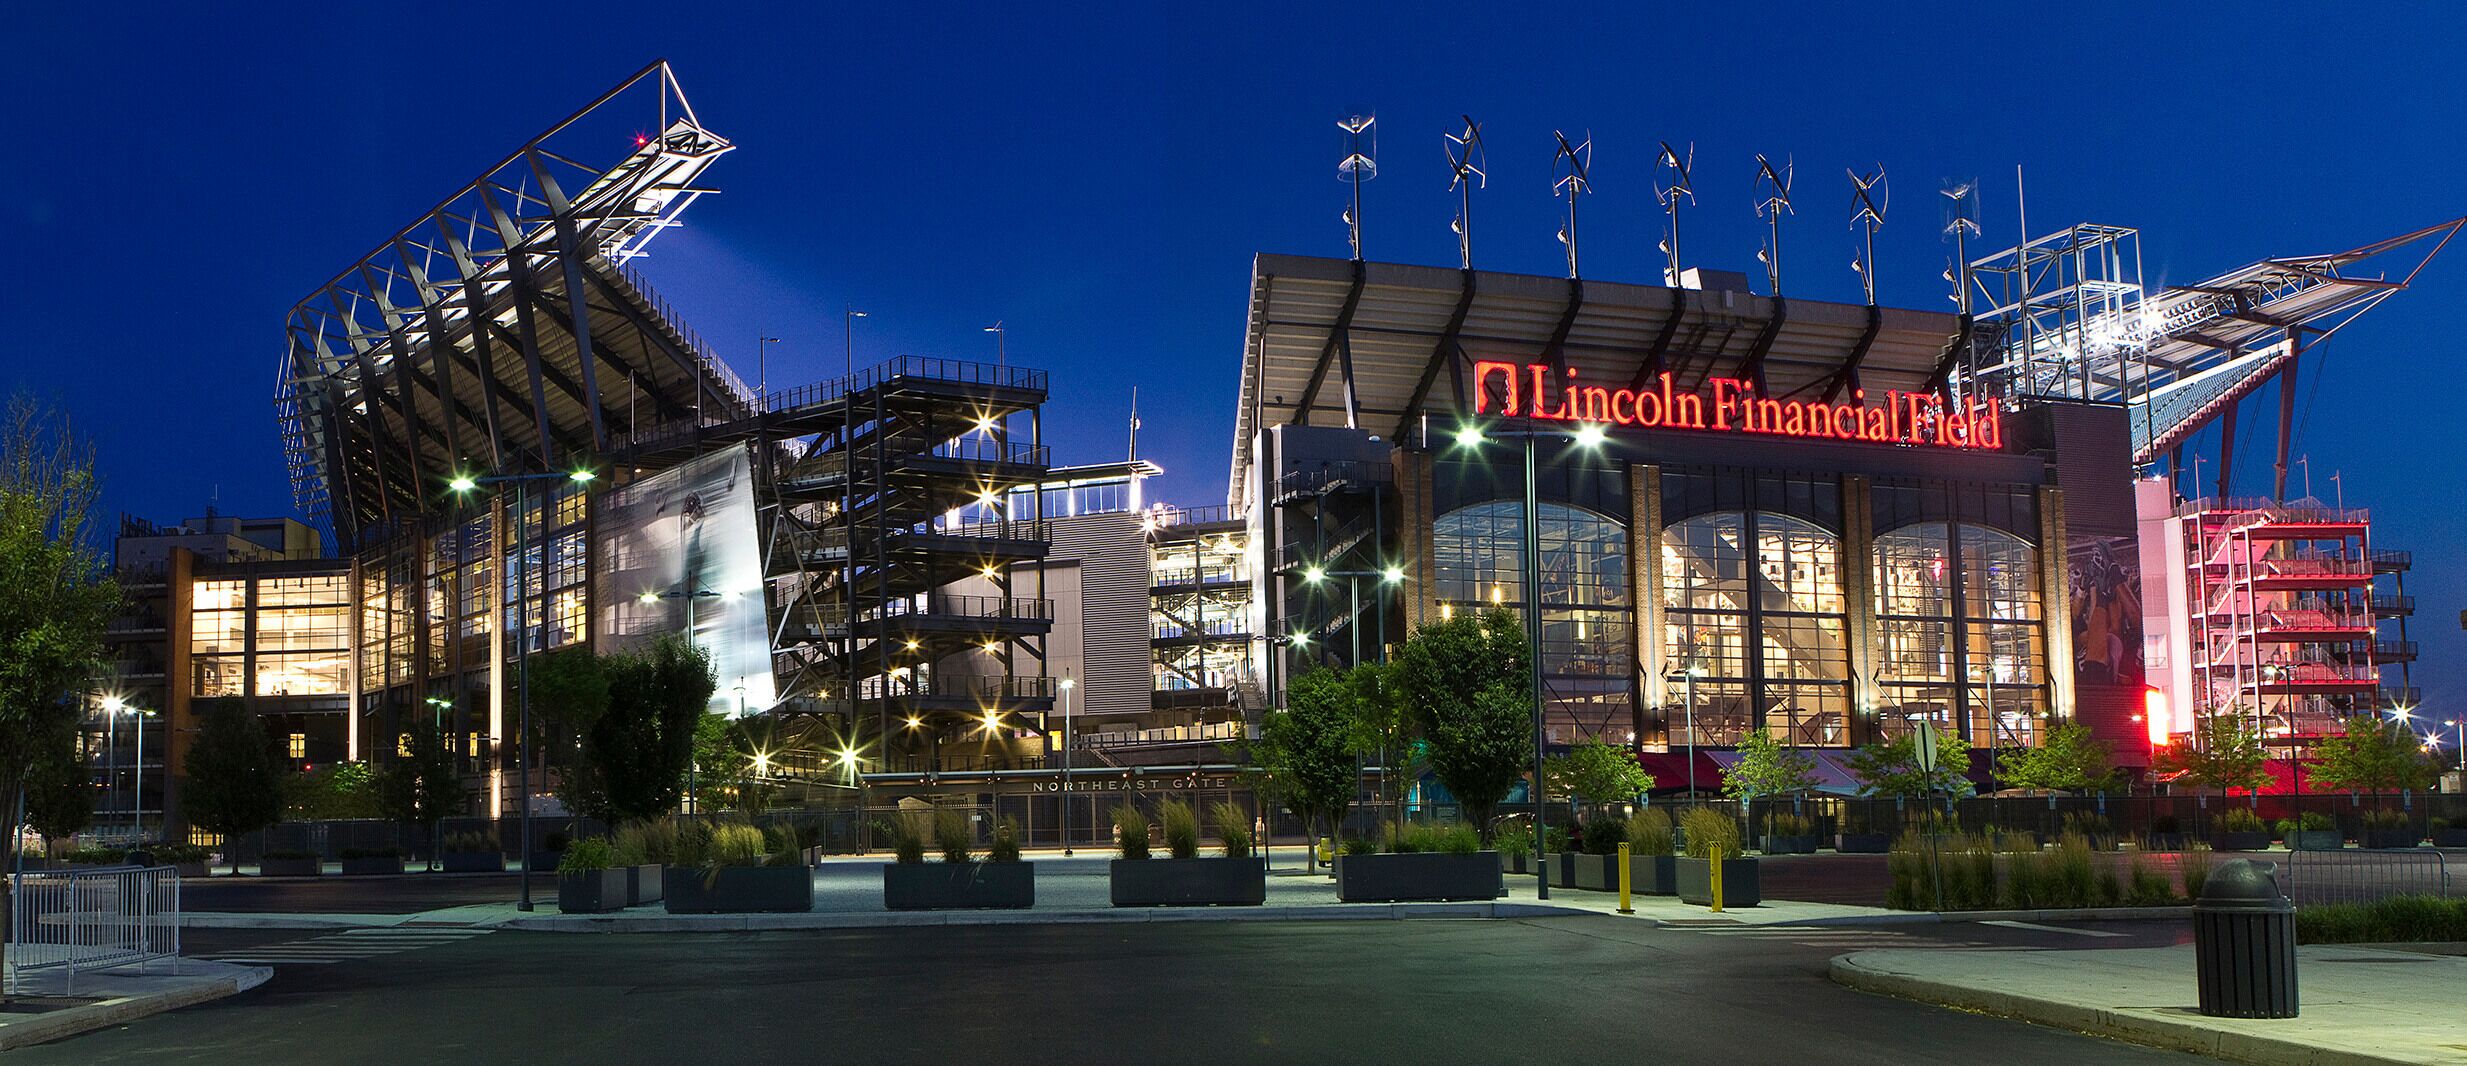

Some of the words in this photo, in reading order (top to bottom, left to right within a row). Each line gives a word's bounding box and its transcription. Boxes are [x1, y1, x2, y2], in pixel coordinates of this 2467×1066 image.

[1528, 364, 1705, 430] Lincoln
[1709, 377, 1901, 443] Financial
[1904, 392, 2003, 450] Field
[1033, 779, 1159, 792] NORTHEAST
[1172, 778, 1226, 789] GATE
